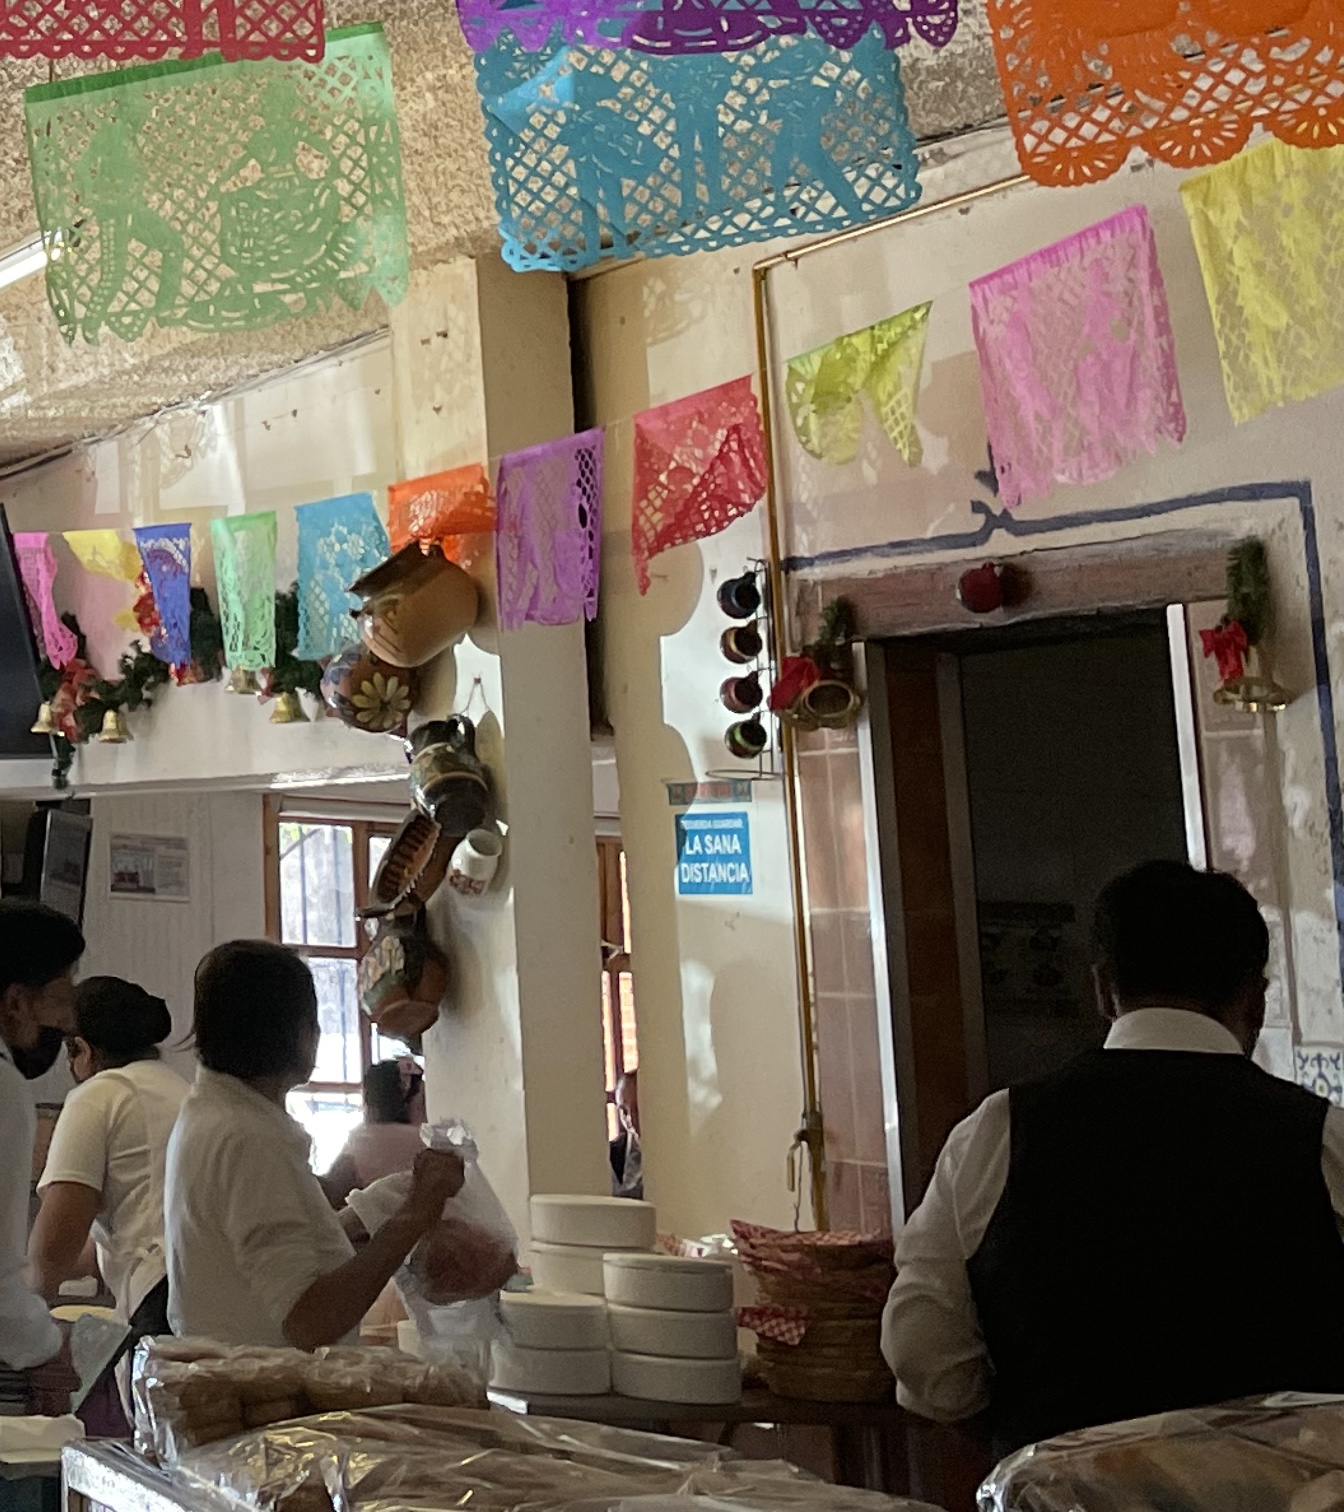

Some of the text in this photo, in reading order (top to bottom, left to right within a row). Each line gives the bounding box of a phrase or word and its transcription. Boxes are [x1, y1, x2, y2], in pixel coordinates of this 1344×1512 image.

[685, 833, 742, 855] LA SANA
[681, 861, 750, 883] DISTANCIA
